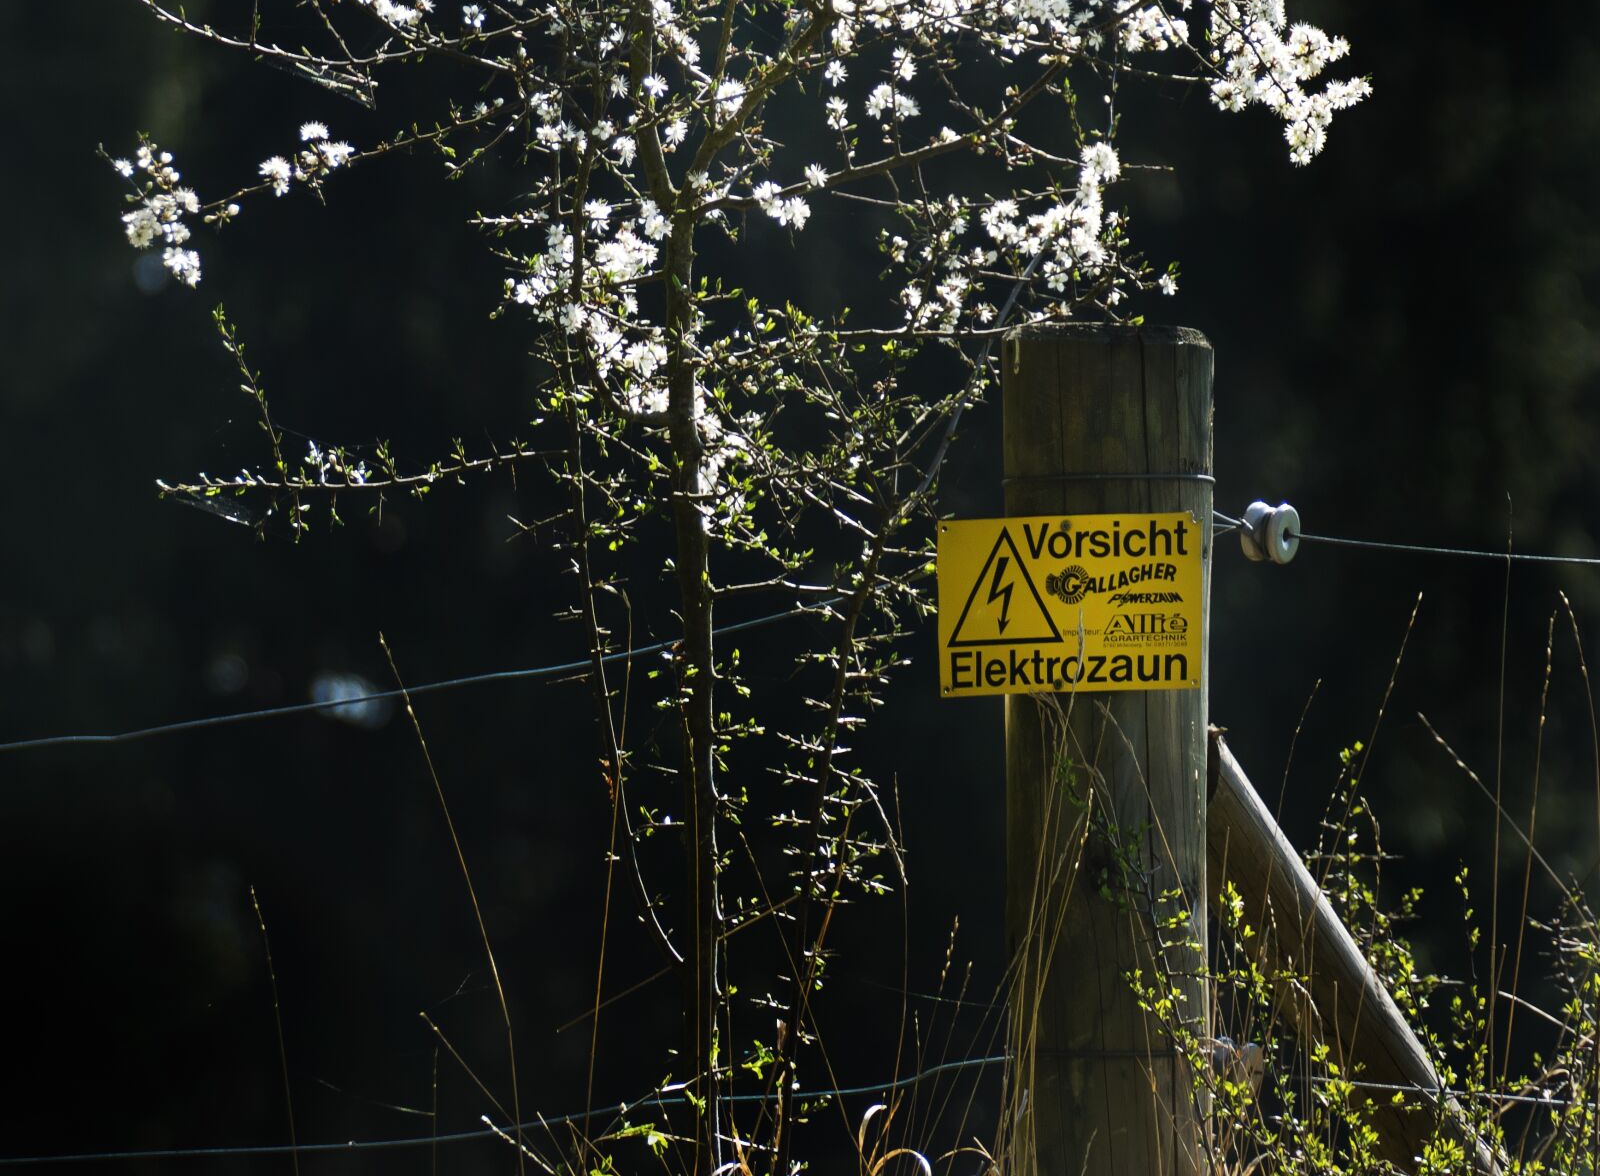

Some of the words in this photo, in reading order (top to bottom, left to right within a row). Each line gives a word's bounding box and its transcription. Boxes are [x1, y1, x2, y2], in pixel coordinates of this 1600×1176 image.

[1023, 521, 1188, 559] Vorsicht
[1060, 563, 1177, 596] GALLAGHER
[1103, 634, 1187, 642] AGRARTECHNIK
[951, 650, 1188, 688] Elektrozaun
